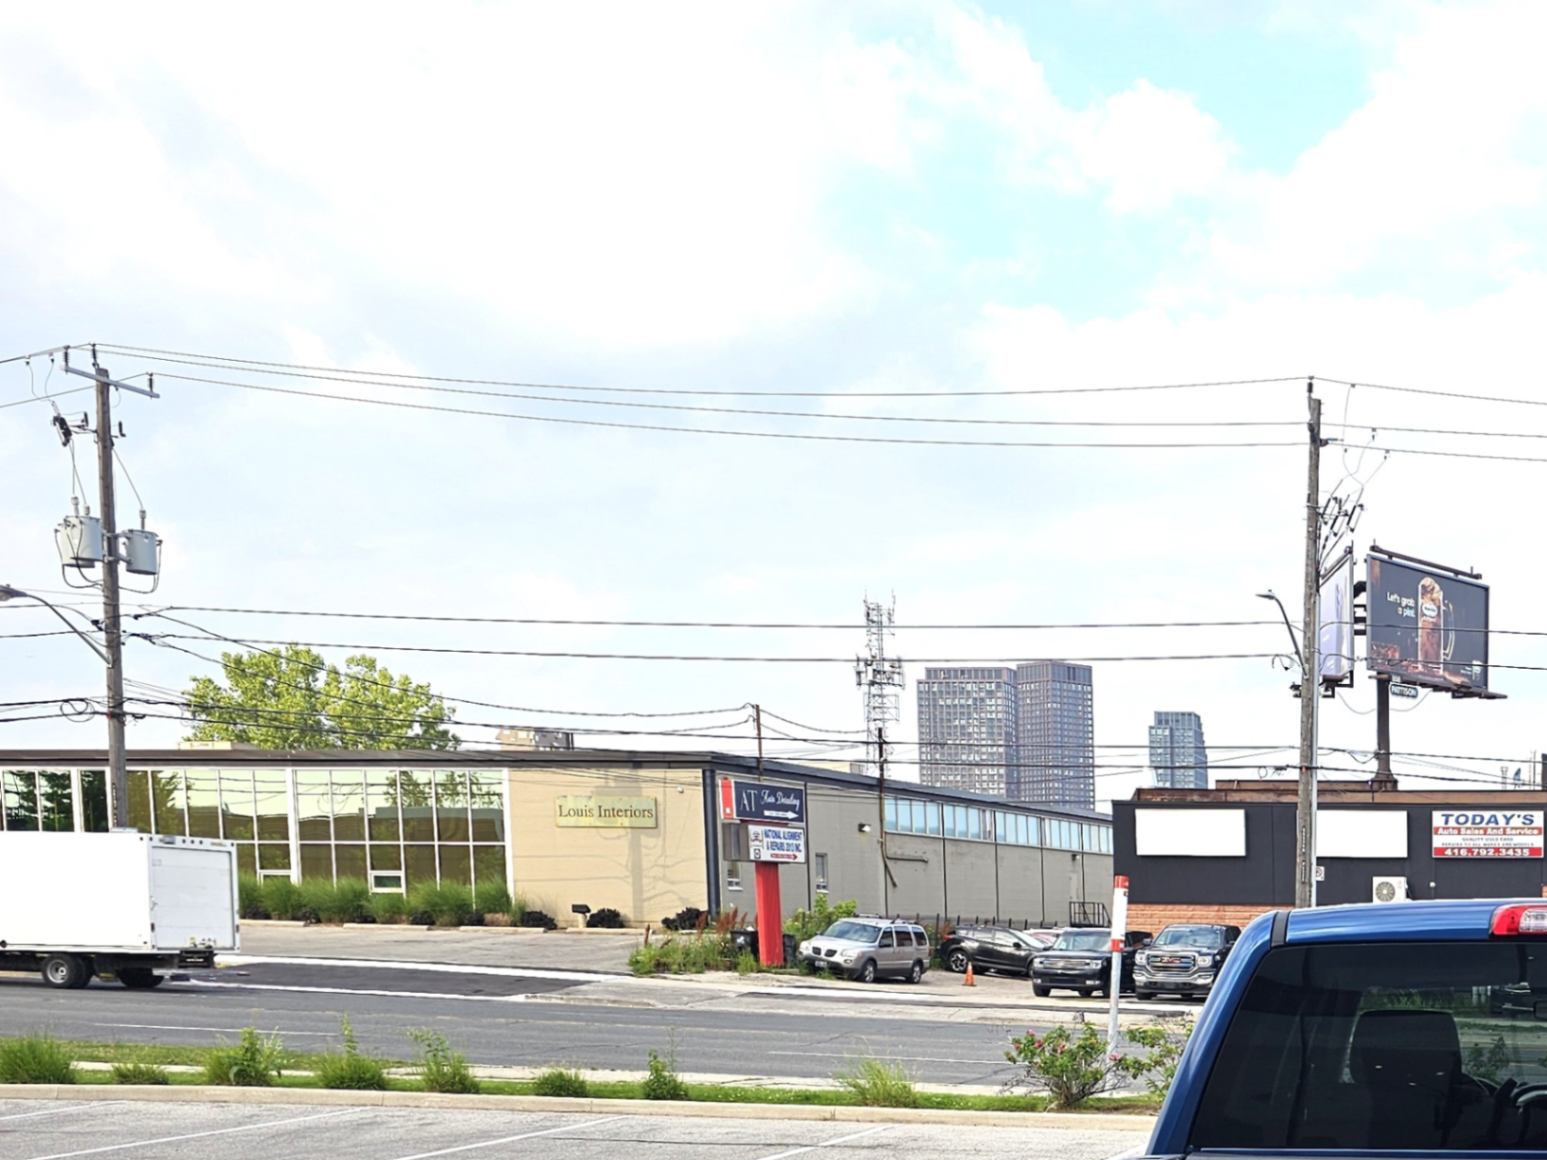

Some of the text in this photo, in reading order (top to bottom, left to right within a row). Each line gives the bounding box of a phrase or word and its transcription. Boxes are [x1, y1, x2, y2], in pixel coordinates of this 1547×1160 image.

[741, 789, 758, 812] AT
[558, 804, 654, 818] Louis Interiors
[1441, 813, 1535, 826] TODAY'S
[1437, 827, 1539, 836] Auto Sales And Service
[1444, 847, 1530, 857] 416.792.3435
